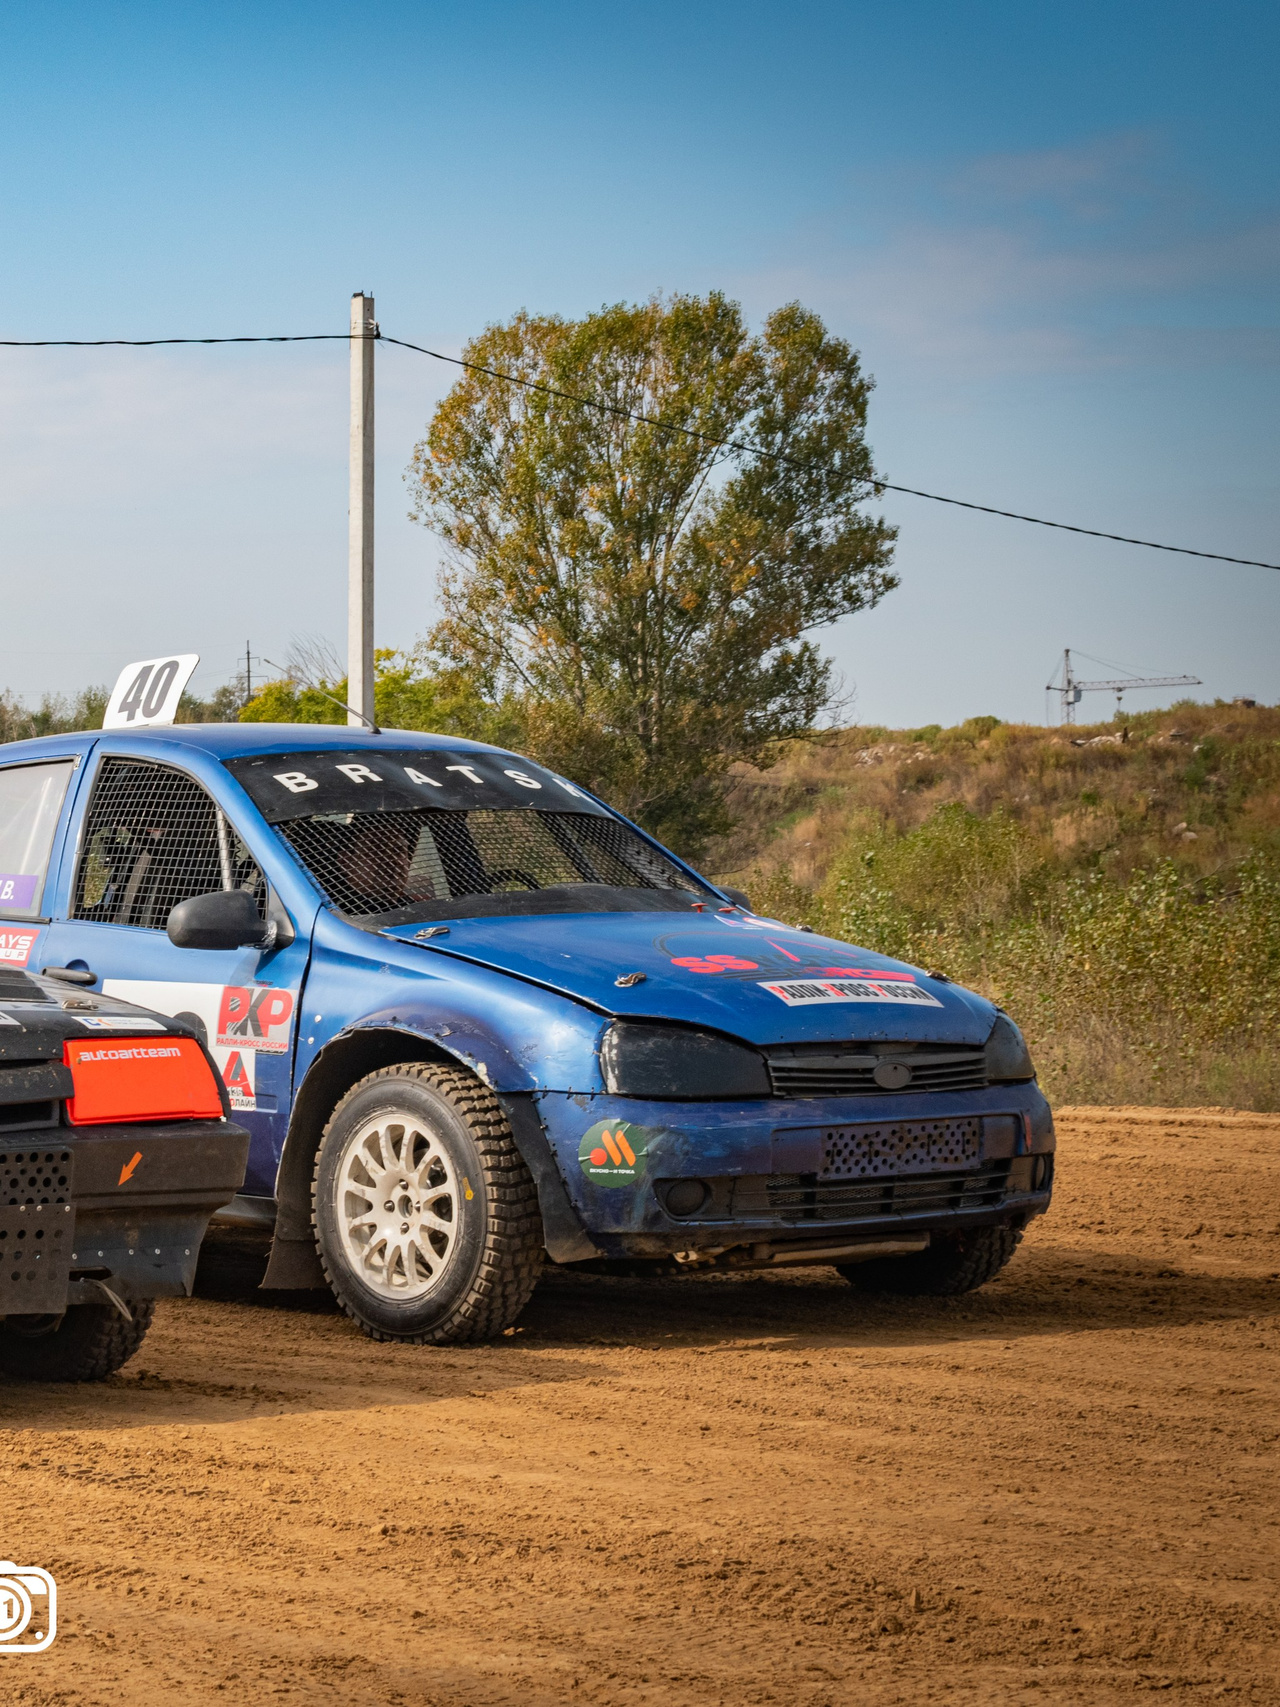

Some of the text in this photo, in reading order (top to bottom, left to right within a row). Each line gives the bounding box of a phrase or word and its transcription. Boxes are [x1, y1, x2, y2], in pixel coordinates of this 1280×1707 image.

[118, 660, 179, 722] 40
[0, 880, 15, 900] В.
[216, 1037, 288, 1050] РАЛЛИ-КРОСС РОССИИ
[79, 1047, 181, 1062] autoartteam
[229, 1097, 256, 1108] ОЛАЙН
